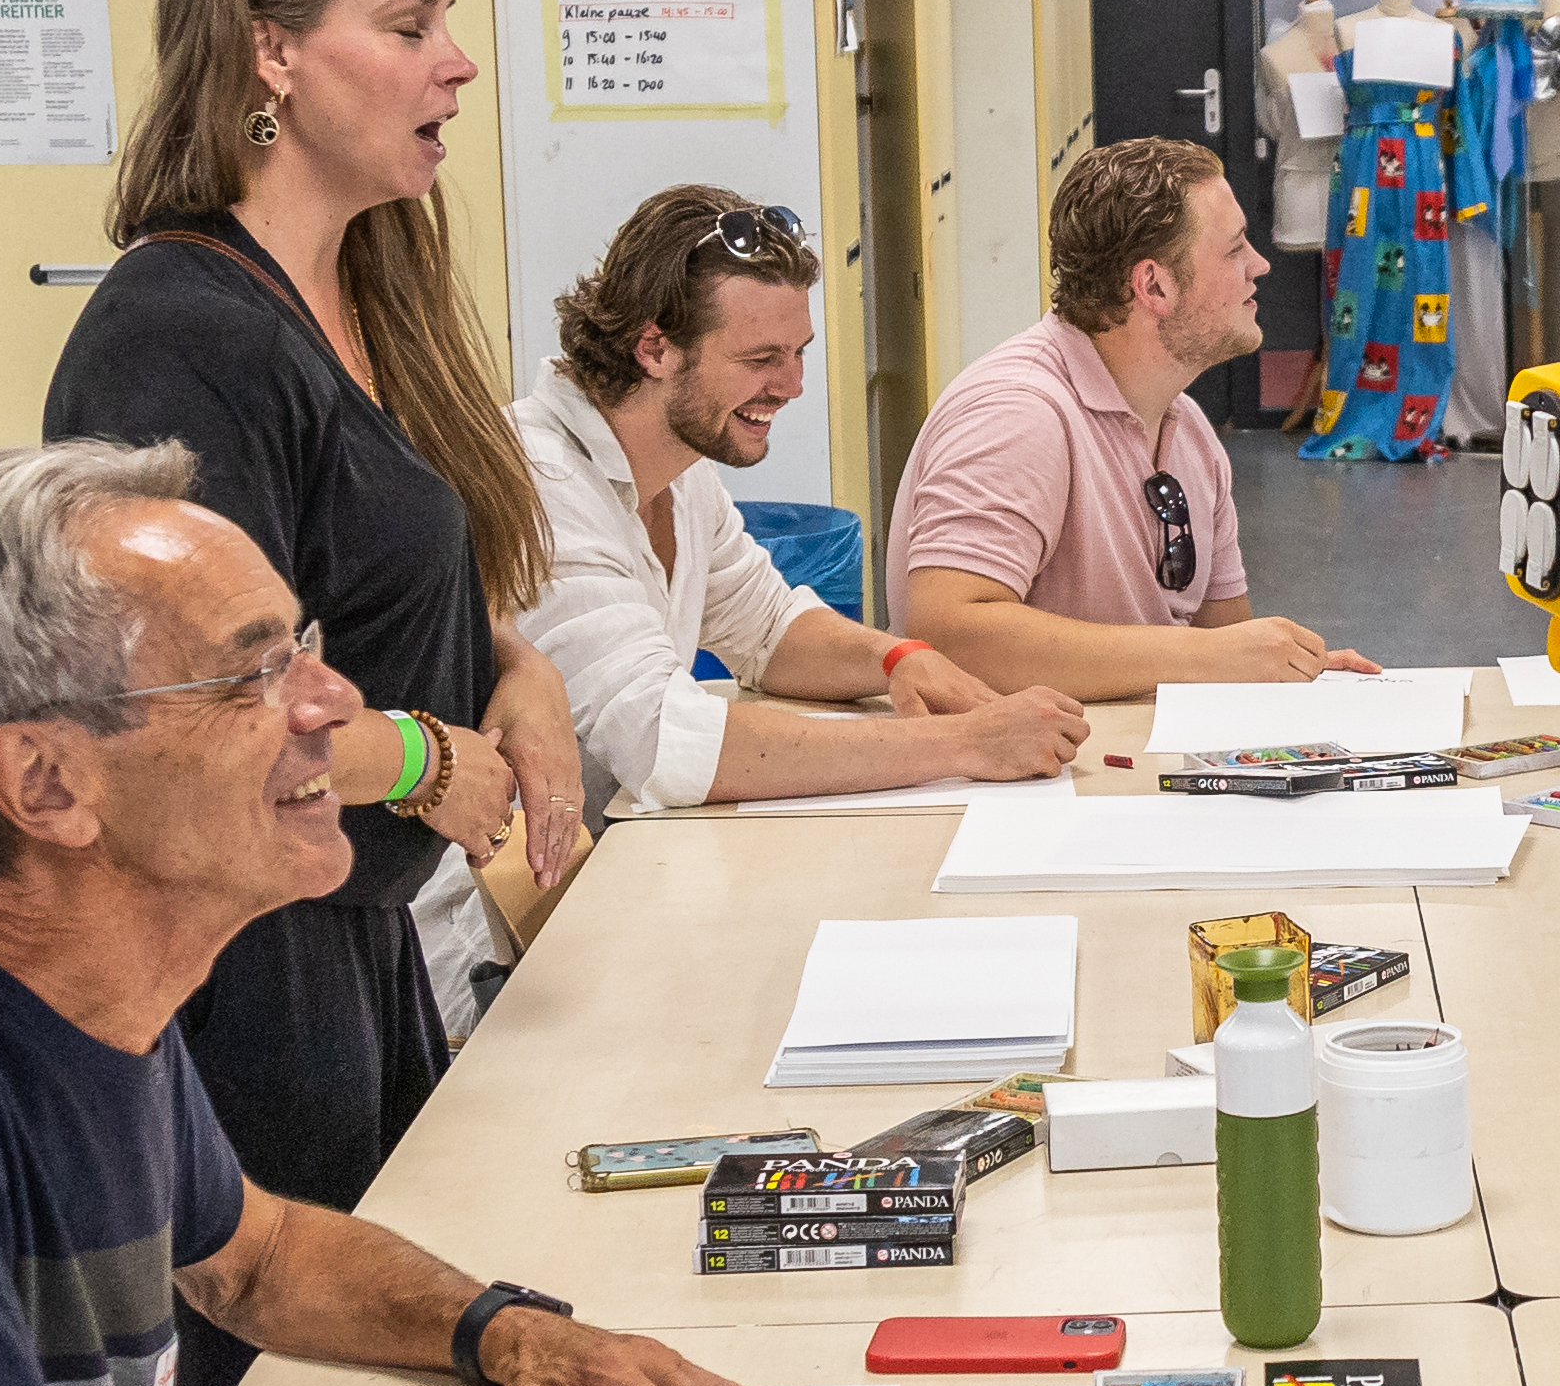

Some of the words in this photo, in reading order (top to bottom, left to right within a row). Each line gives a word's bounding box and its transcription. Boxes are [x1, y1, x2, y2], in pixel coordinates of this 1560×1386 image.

[608, 7, 650, 23] pauze
[1162, 779, 1171, 788] 12
[1421, 772, 1455, 785] PANDA
[1386, 960, 1408, 979] PANDA
[760, 1156, 920, 1171] PANDA
[710, 1201, 725, 1211] 12
[894, 1195, 949, 1209] PANDA
[713, 1229, 729, 1240] 12
[709, 1257, 725, 1267] 12
[890, 1247, 945, 1261] PANDA
